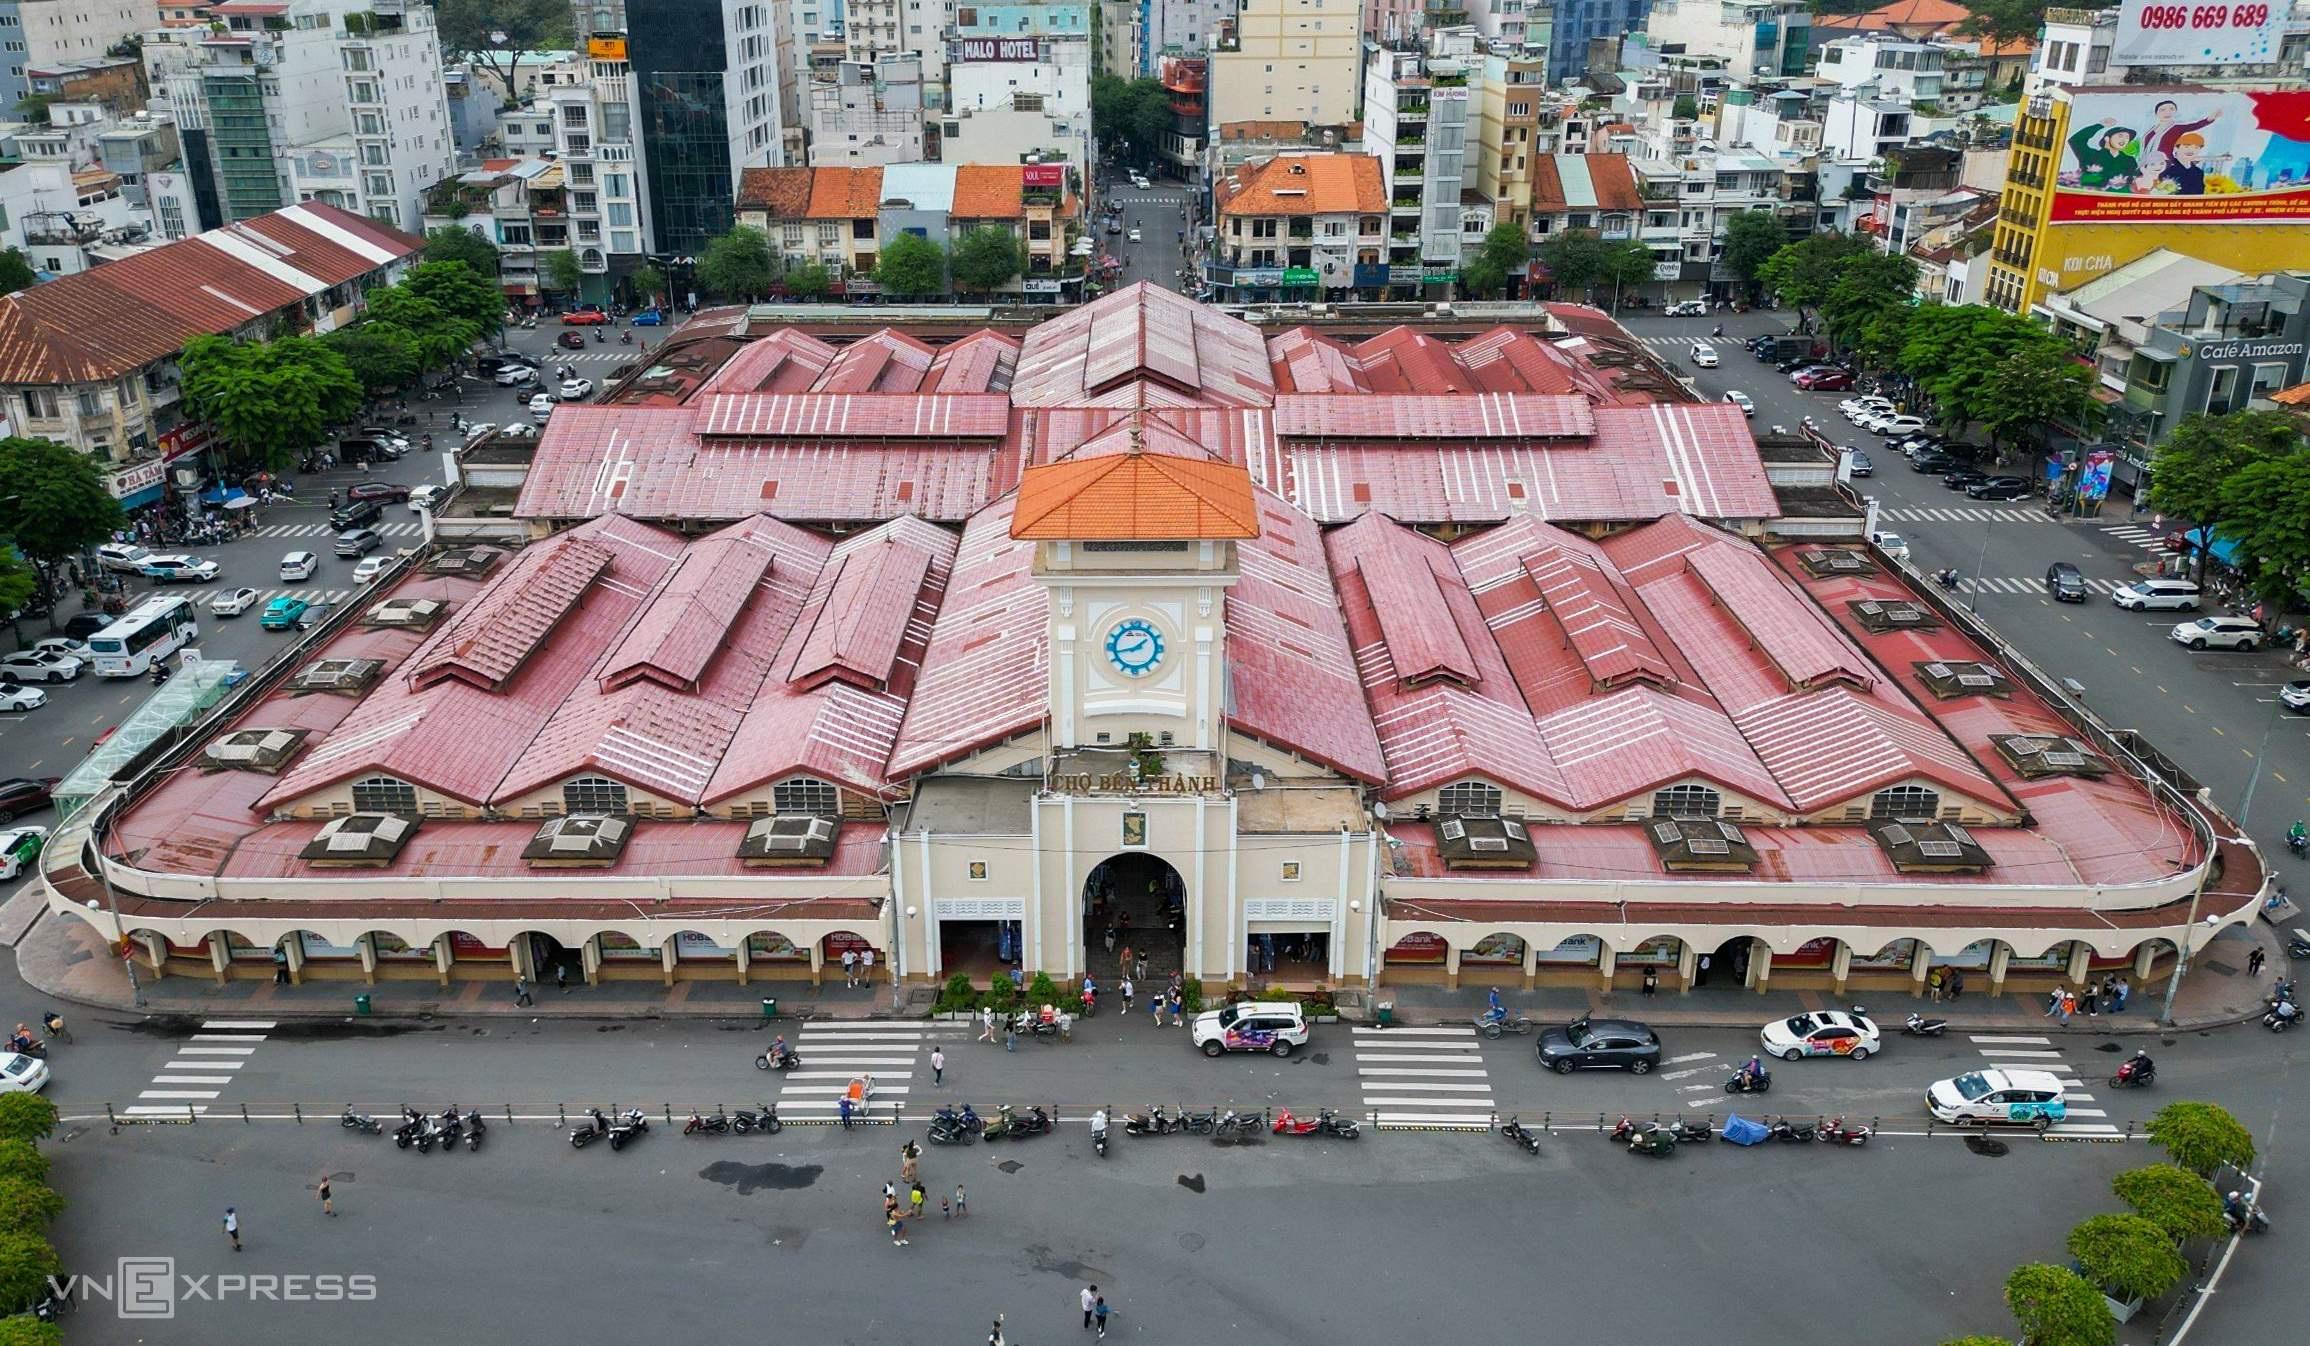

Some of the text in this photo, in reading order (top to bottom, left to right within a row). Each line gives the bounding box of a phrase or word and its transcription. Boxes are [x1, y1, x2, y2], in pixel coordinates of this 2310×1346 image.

[2140, 3, 2268, 29] 0986 669 689
[964, 41, 1037, 58] HALO HOTEL
[2064, 255, 2112, 272] KOI CHA
[2200, 342, 2303, 359] Café Amazon
[127, 471, 142, 486] HÀ
[1051, 772, 1092, 792] CHỢ
[682, 933, 713, 941] HDBa
